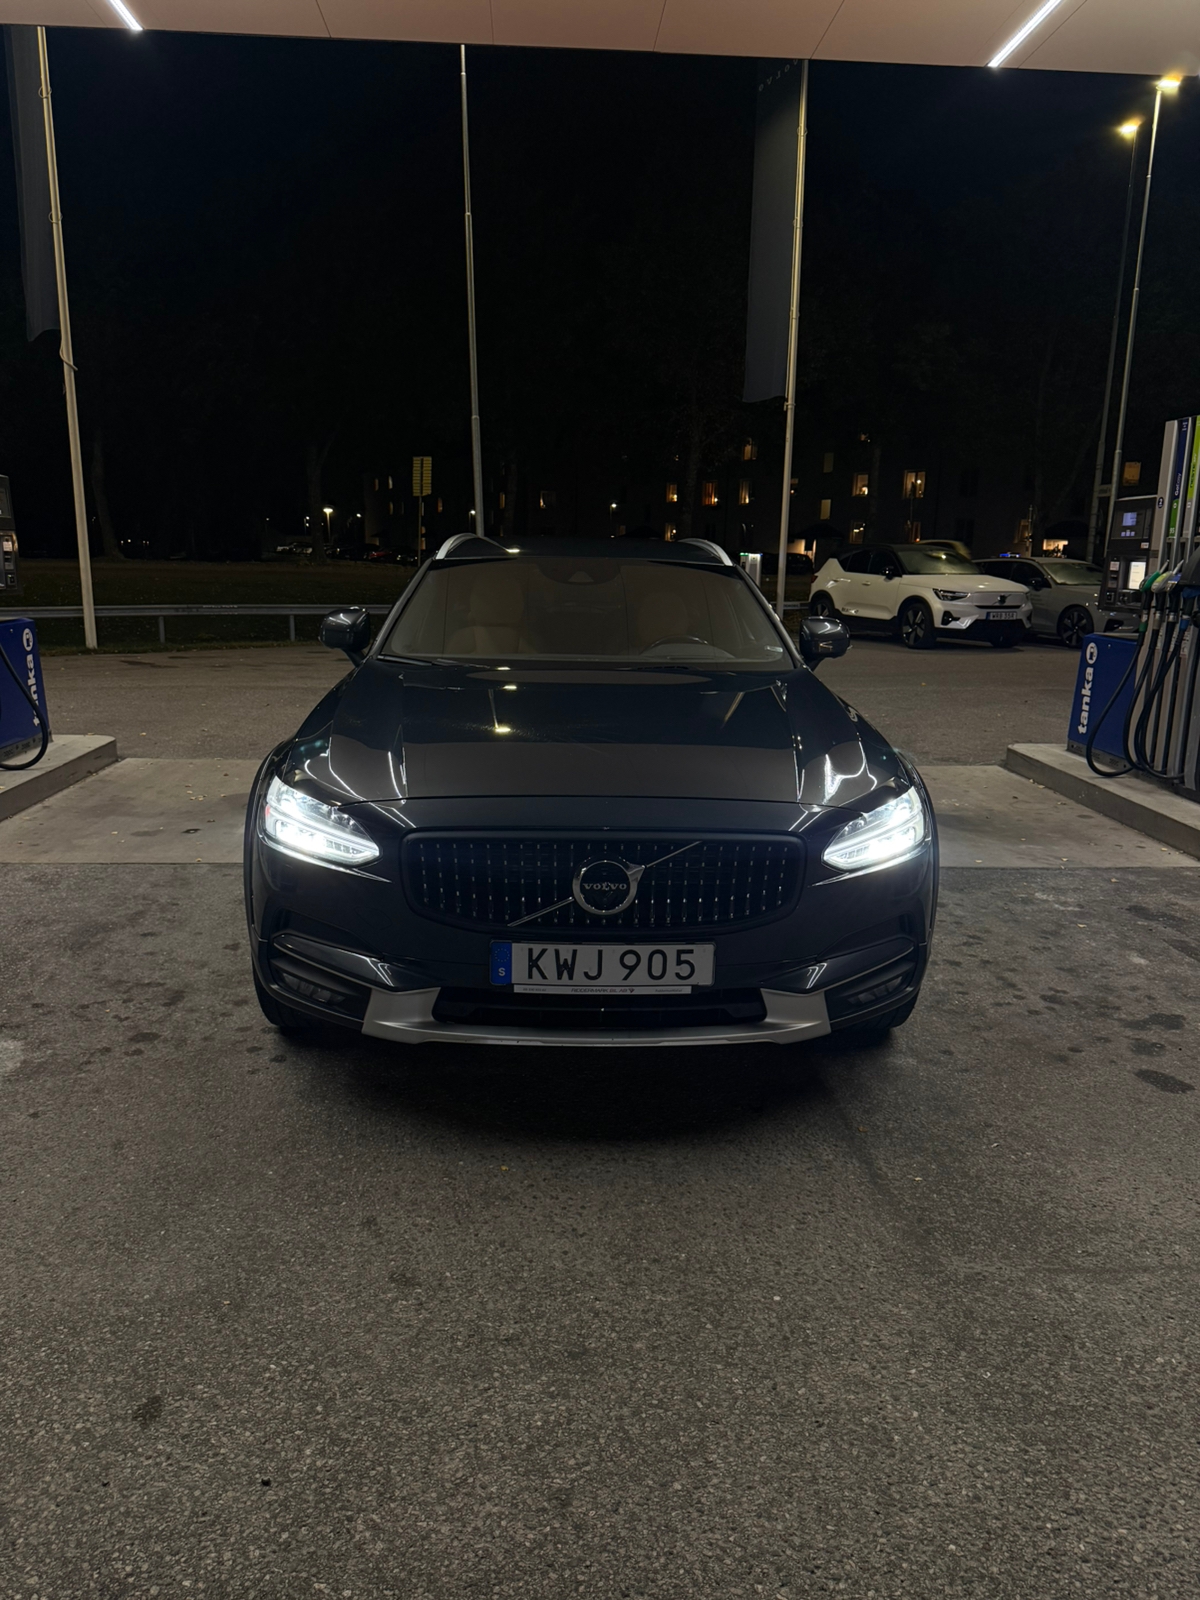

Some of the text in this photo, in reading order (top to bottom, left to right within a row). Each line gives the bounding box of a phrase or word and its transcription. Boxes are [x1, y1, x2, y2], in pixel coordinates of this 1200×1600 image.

[1077, 667, 1094, 734] tanka
[498, 948, 696, 981] S KWJ 905
